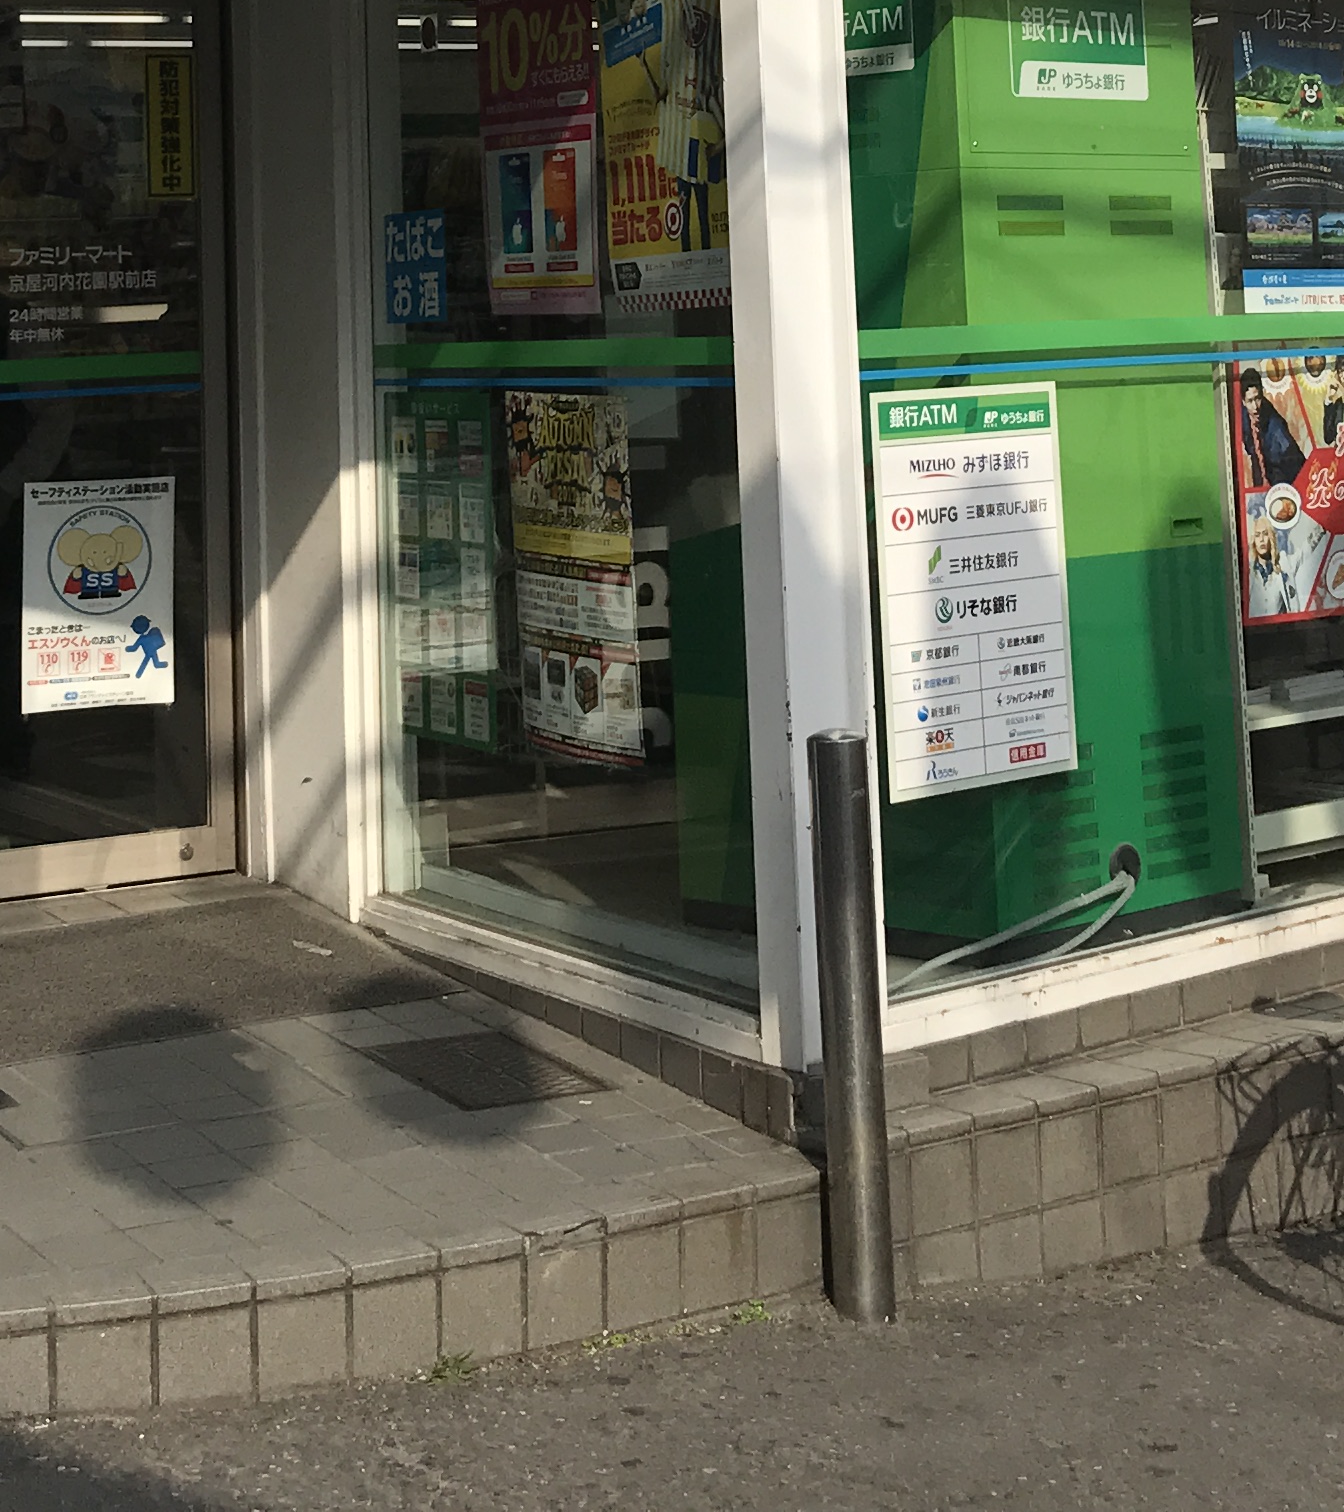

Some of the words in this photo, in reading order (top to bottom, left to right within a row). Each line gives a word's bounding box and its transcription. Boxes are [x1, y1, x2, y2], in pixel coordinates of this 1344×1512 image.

[1020, 6, 1135, 46] 銀行ATM
[1062, 72, 1125, 91] ゆうちょ銀行
[159, 60, 182, 192] 防犯対策強化中
[612, 205, 663, 246] 当たる
[386, 215, 444, 264] たばこ
[9, 245, 133, 266] ファミリーマート
[9, 271, 157, 294] 京屋河内花園駅前店
[392, 271, 440, 318] お酒
[9, 306, 84, 324] 24時間営業
[9, 328, 65, 344] 年中無休
[889, 403, 957, 429] 銀行ATM
[1001, 409, 1044, 425] ゆうちょ銀行
[909, 457, 955, 474] MIZUHO
[963, 450, 1029, 474] みずほ銀行
[917, 505, 958, 526] MUFG
[966, 498, 1048, 520] 三菱東京UFJ銀行
[949, 551, 1018, 574] 三井住友銀行
[86, 573, 114, 588] SS
[957, 594, 1017, 619] りそな銀行
[39, 654, 59, 665] 110
[70, 651, 89, 663] 119
[926, 645, 959, 661] 京都銀行
[931, 704, 960, 718] 新生銀行
[1010, 744, 1046, 762] 信用金庫
